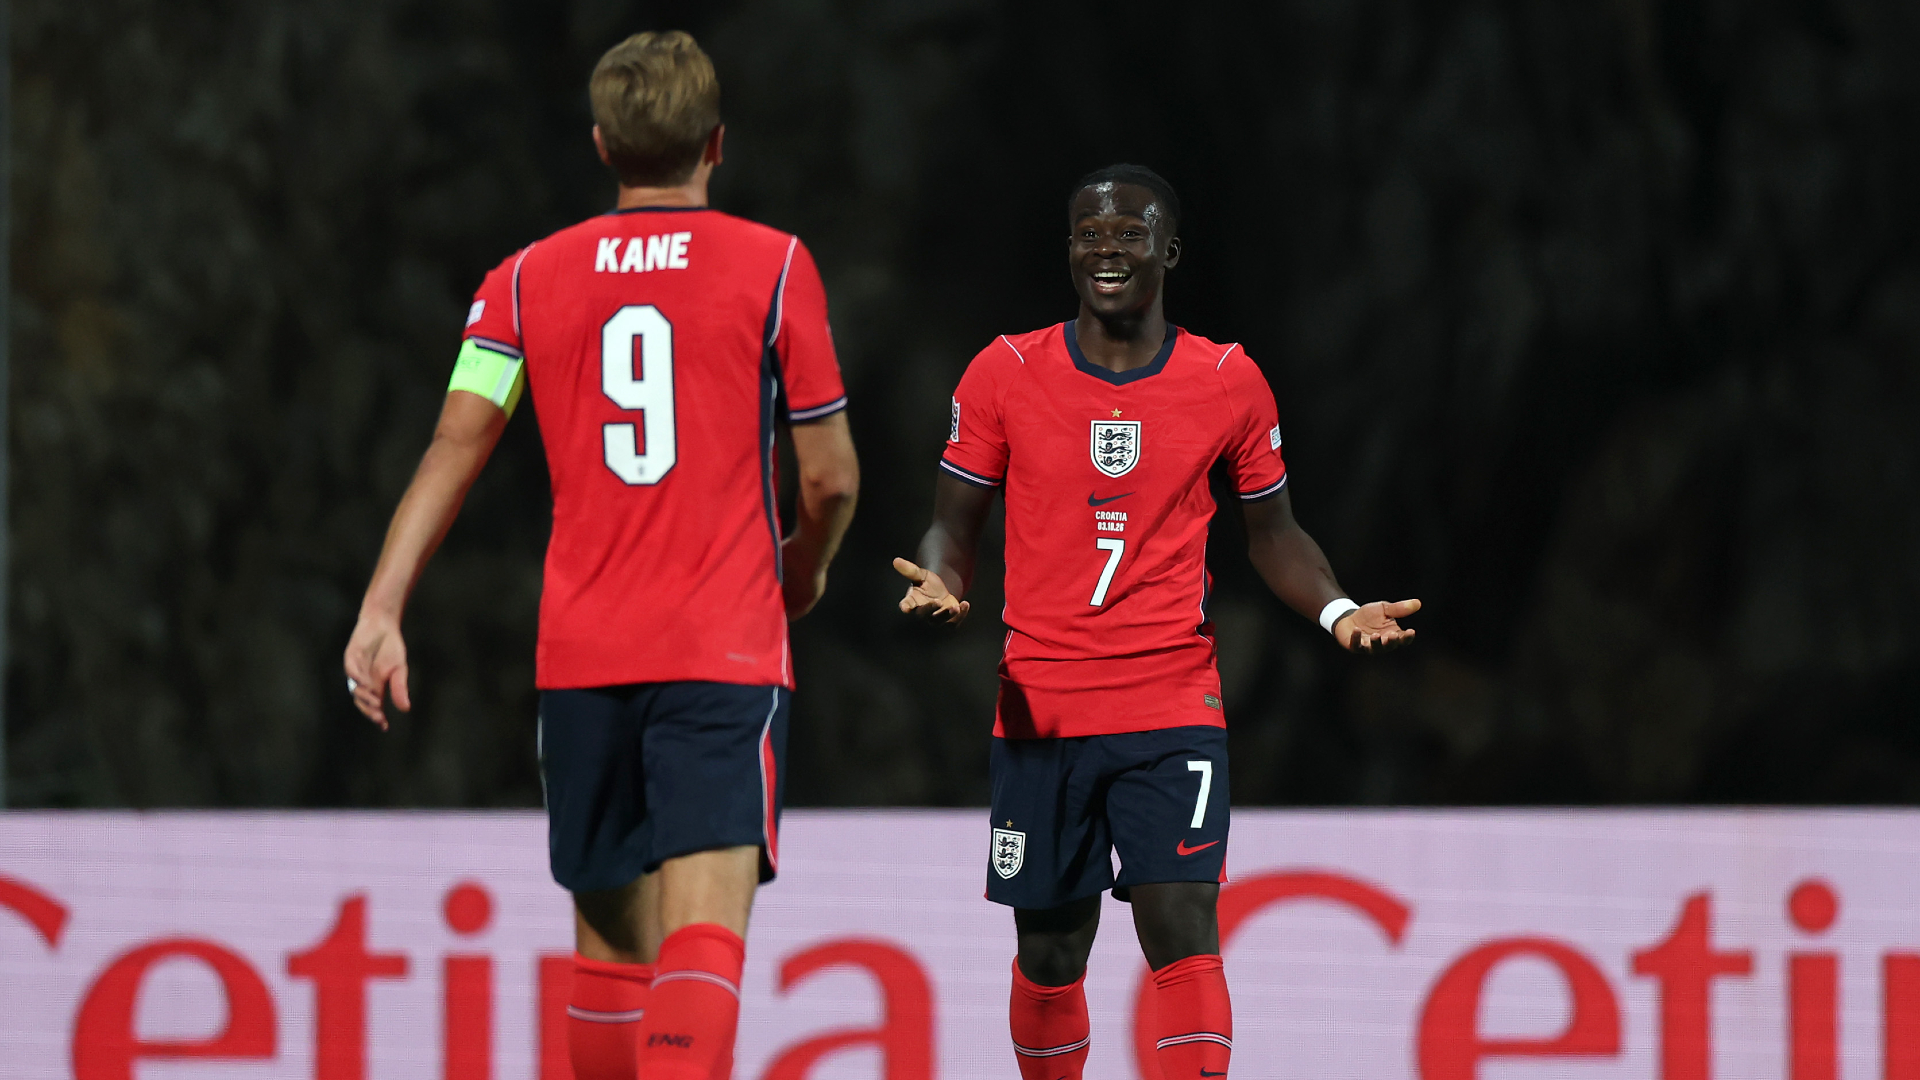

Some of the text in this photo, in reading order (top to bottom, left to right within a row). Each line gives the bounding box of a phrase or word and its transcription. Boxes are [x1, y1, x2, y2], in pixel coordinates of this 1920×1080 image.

[595, 231, 692, 273] KANE
[601, 304, 677, 485] 9
[1095, 511, 1128, 521] CROATIA
[1089, 537, 1125, 607] 7
[1187, 760, 1212, 829] 7
[0, 872, 938, 1080] etia
[1129, 868, 1920, 1080] Ceti
